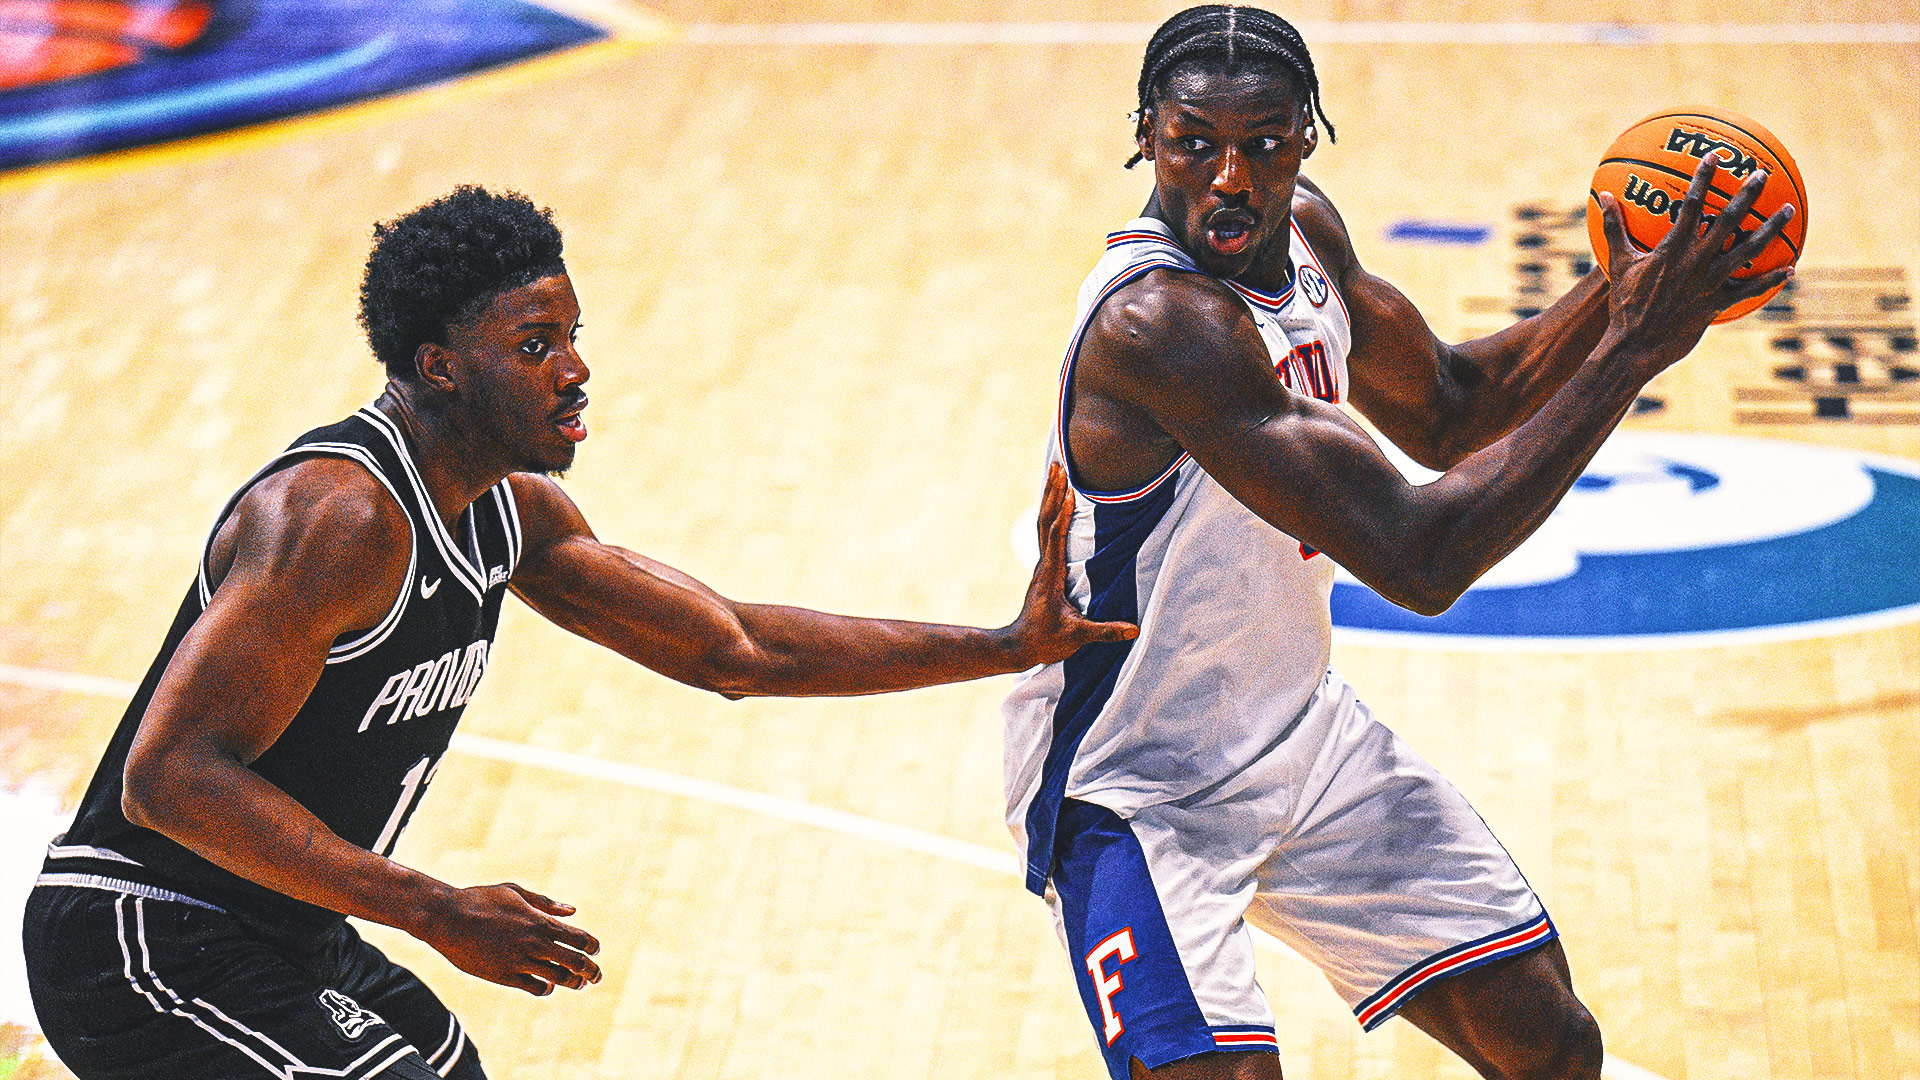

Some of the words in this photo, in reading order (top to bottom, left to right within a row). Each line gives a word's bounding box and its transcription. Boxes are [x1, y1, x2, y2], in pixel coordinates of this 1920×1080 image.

[357, 639, 493, 732] PROVIDE
[371, 757, 441, 855] 1
[1084, 925, 1138, 1048] F
